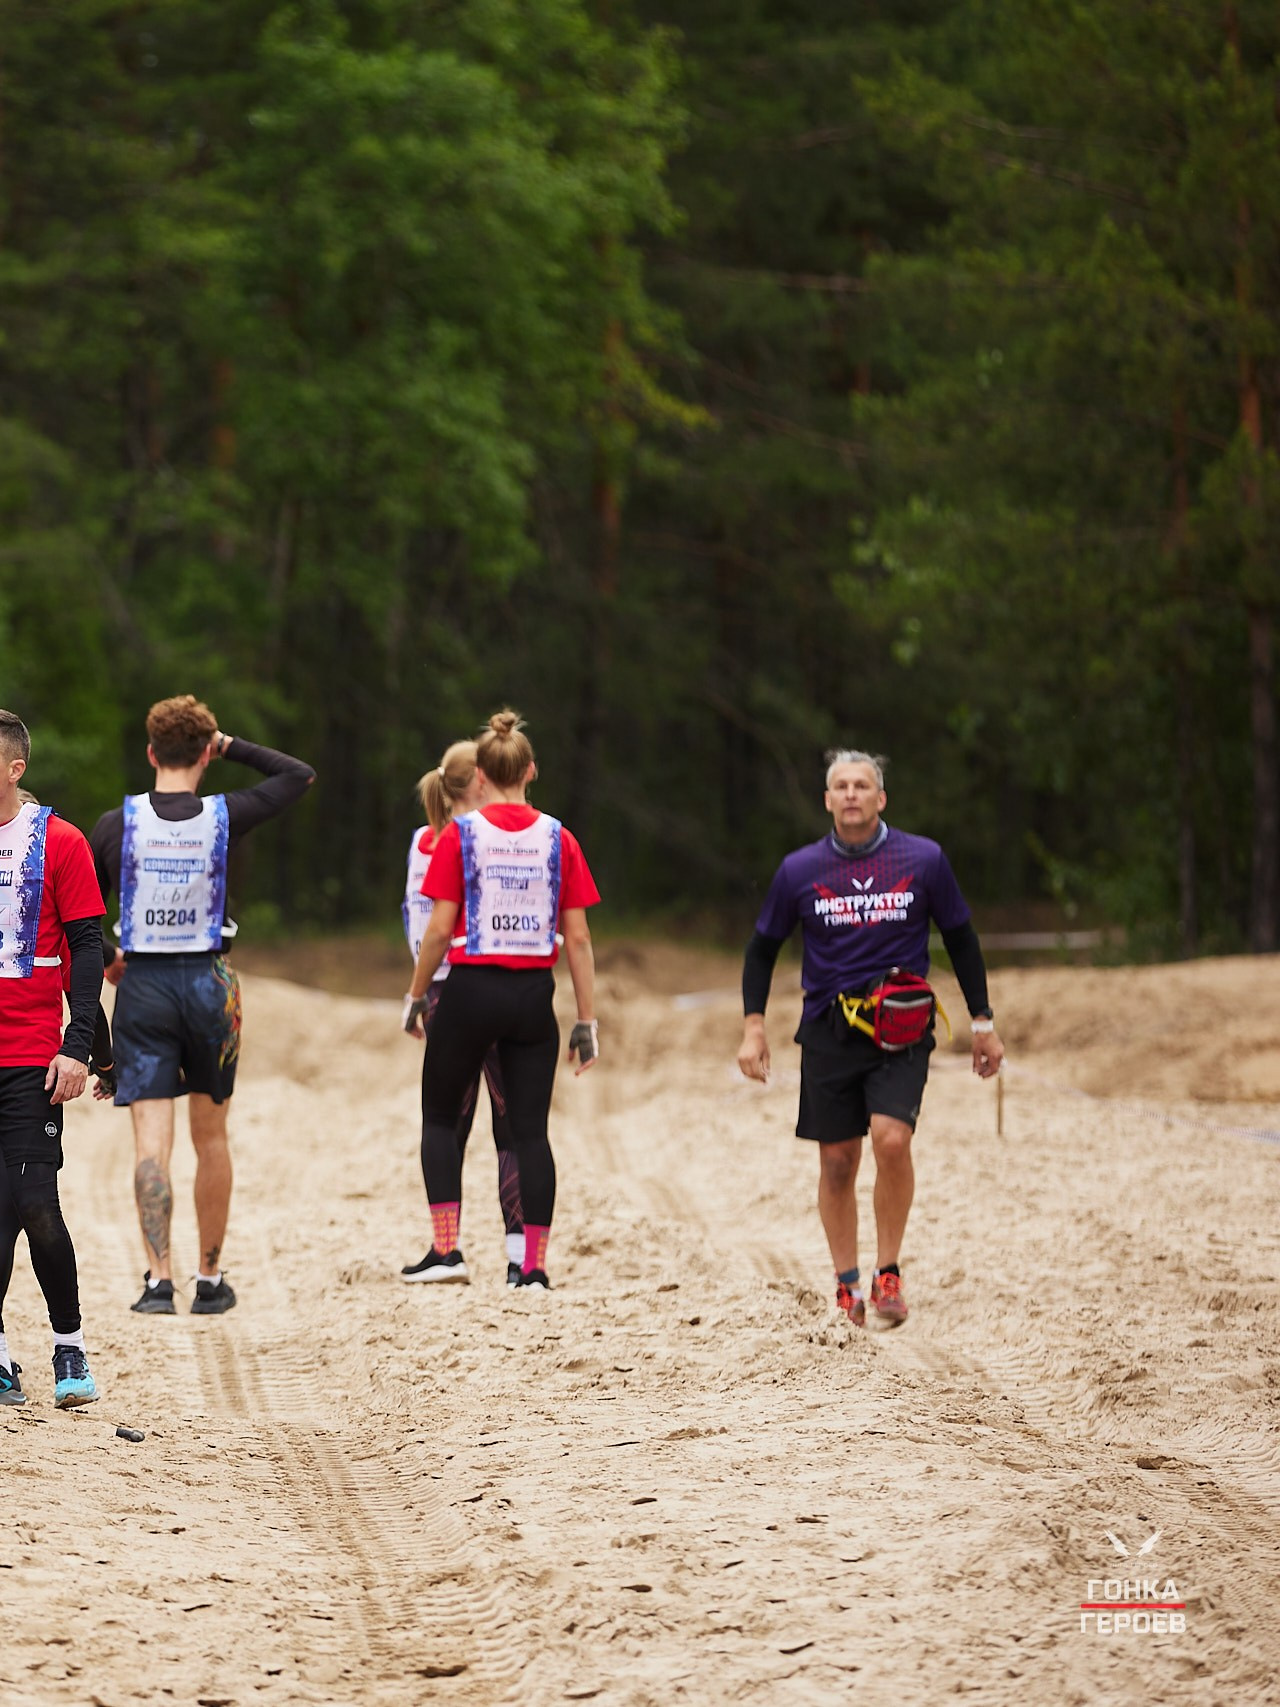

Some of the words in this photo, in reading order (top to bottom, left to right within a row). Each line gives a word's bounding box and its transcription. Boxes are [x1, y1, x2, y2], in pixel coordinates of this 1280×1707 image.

[145, 859, 204, 872] КОМАНДНЫЙ
[814, 891, 914, 915] ИНСТРУКТОР
[145, 909, 196, 926] 03204
[492, 914, 540, 931] 03205
[824, 911, 862, 927] ГОНКА
[864, 909, 908, 924] ГЕРОЕВ
